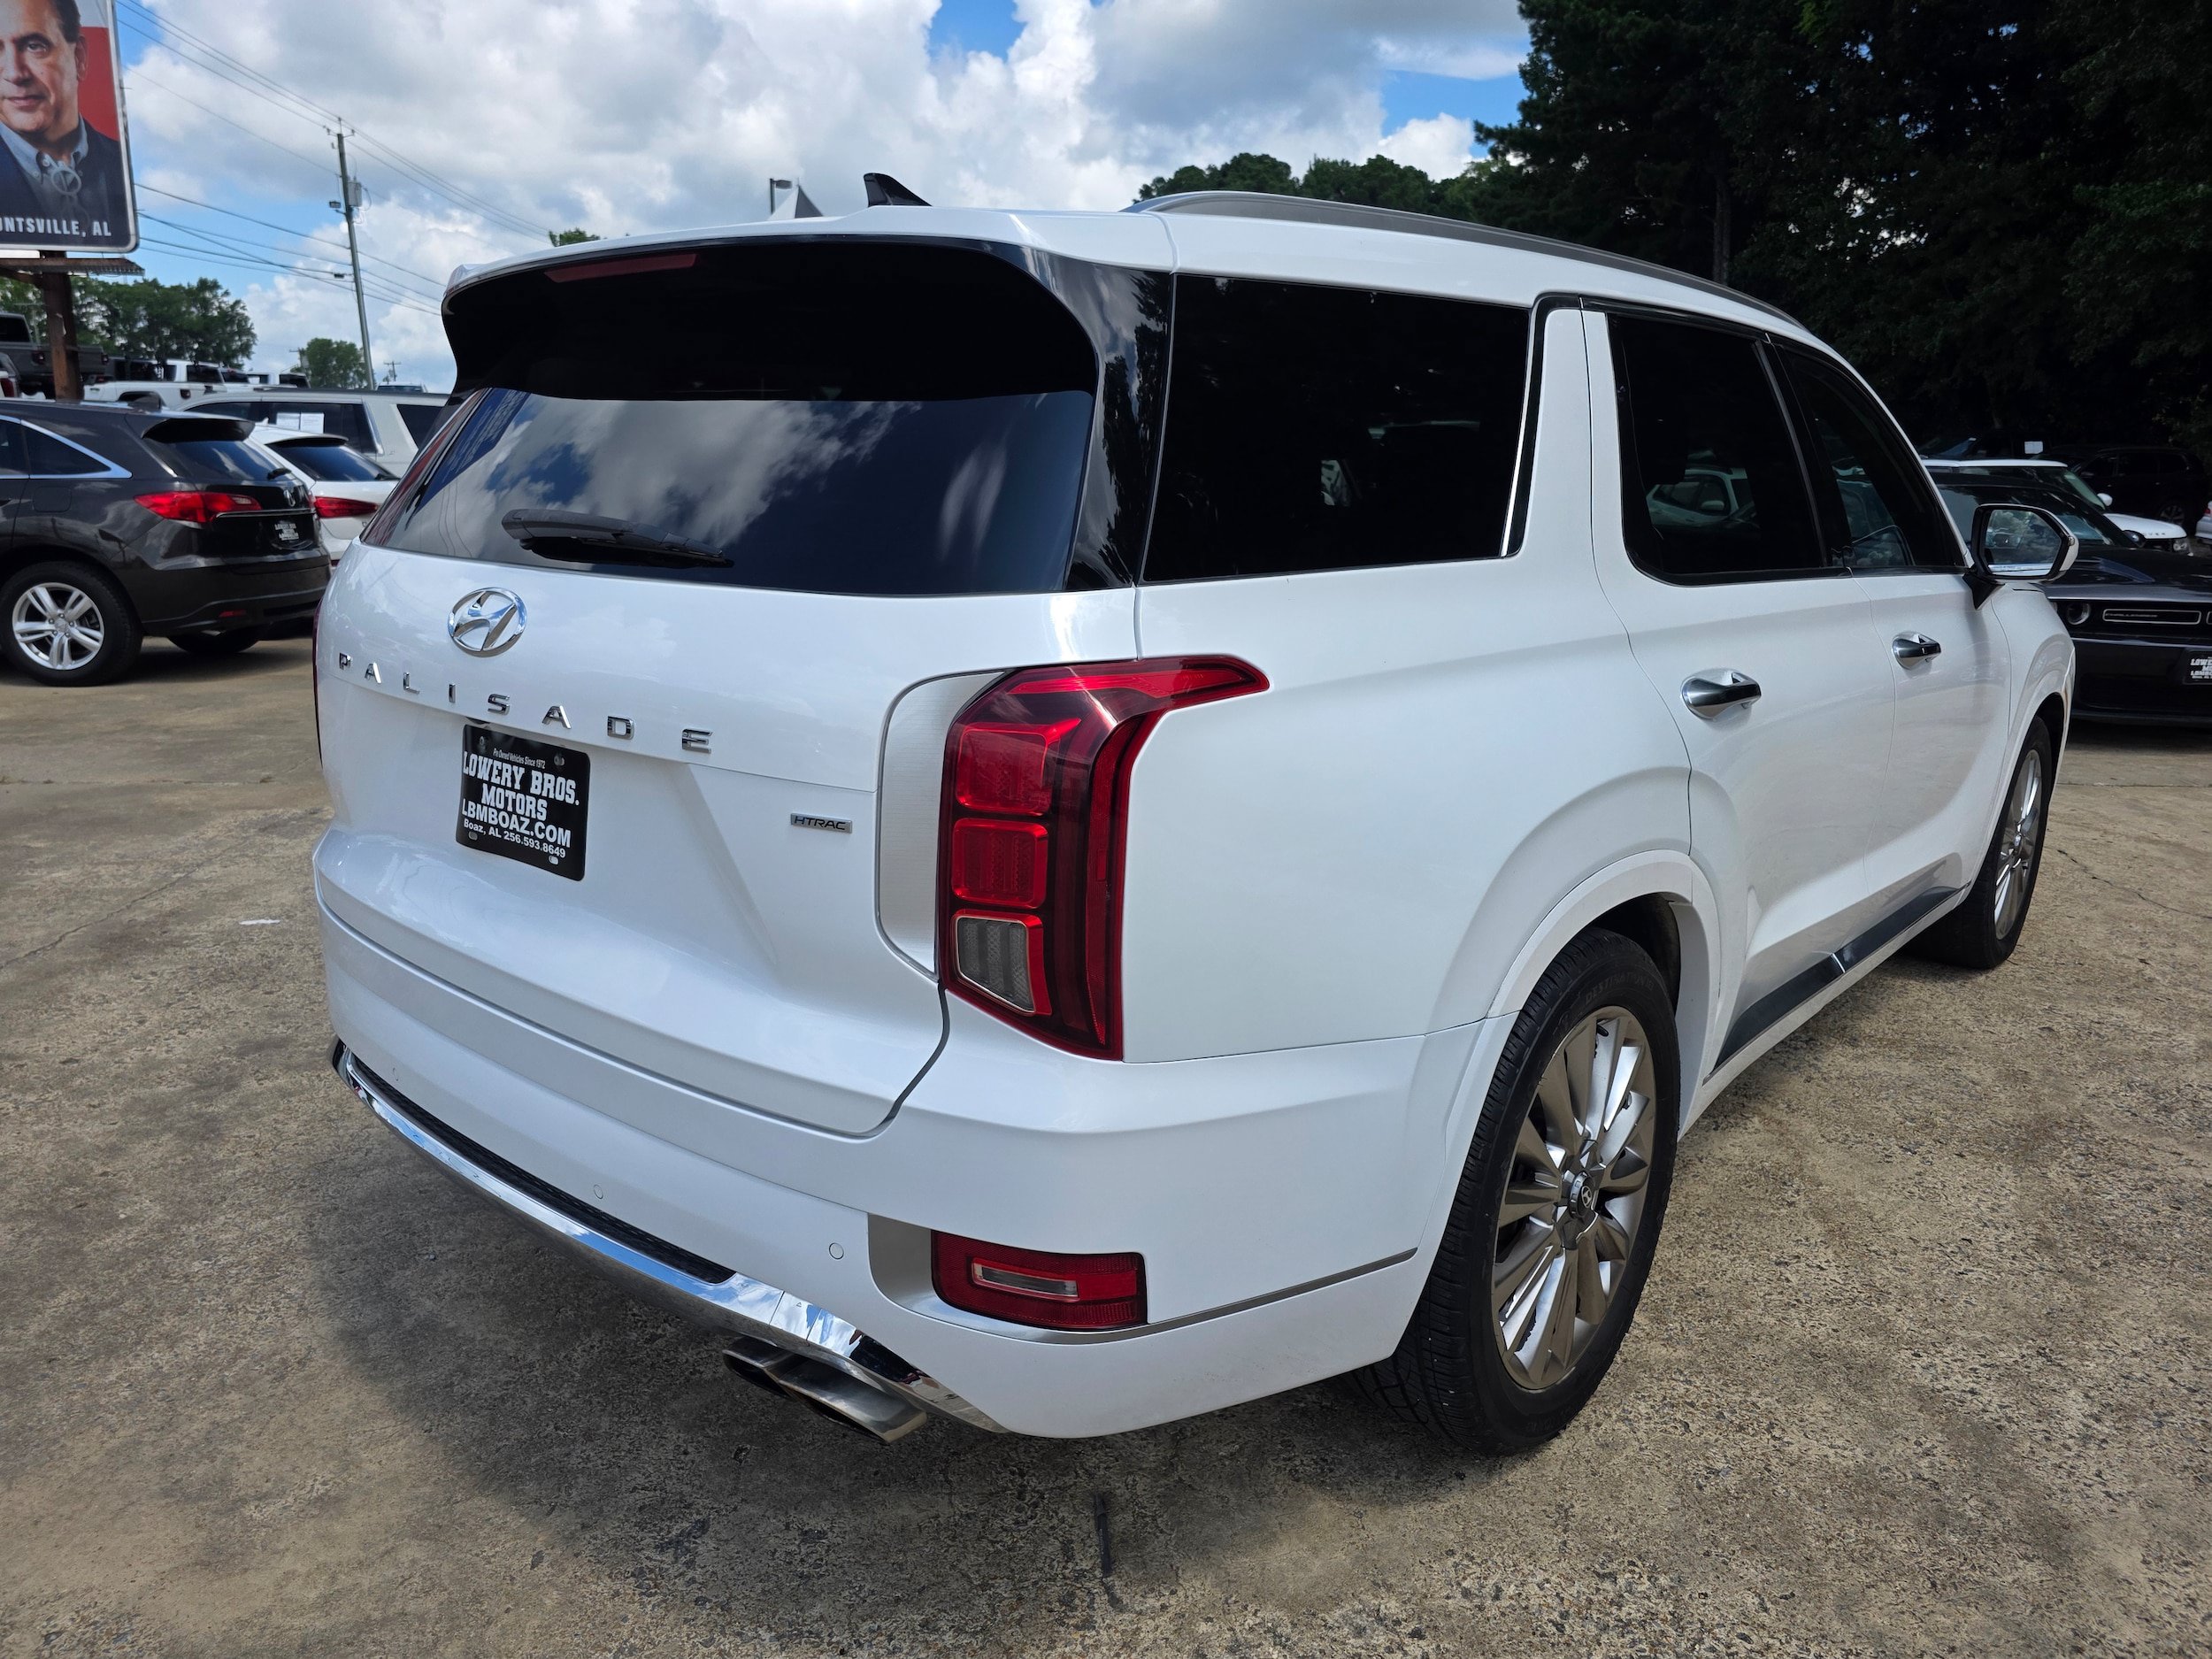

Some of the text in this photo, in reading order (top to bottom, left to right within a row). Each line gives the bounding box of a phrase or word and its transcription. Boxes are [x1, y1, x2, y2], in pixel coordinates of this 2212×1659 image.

[0, 217, 111, 237] NTSVILLE, AL
[339, 652, 713, 754] PALISADE
[463, 751, 580, 805] LOWERY BROS.
[525, 757, 535, 766] Since
[536, 759, 546, 769] 1972
[481, 783, 548, 821] MOTORS
[462, 799, 572, 848] LBMBOAZ.COM
[464, 818, 566, 858] Boaz, AL 256.593.8649
[795, 816, 846, 830] HTRAC
